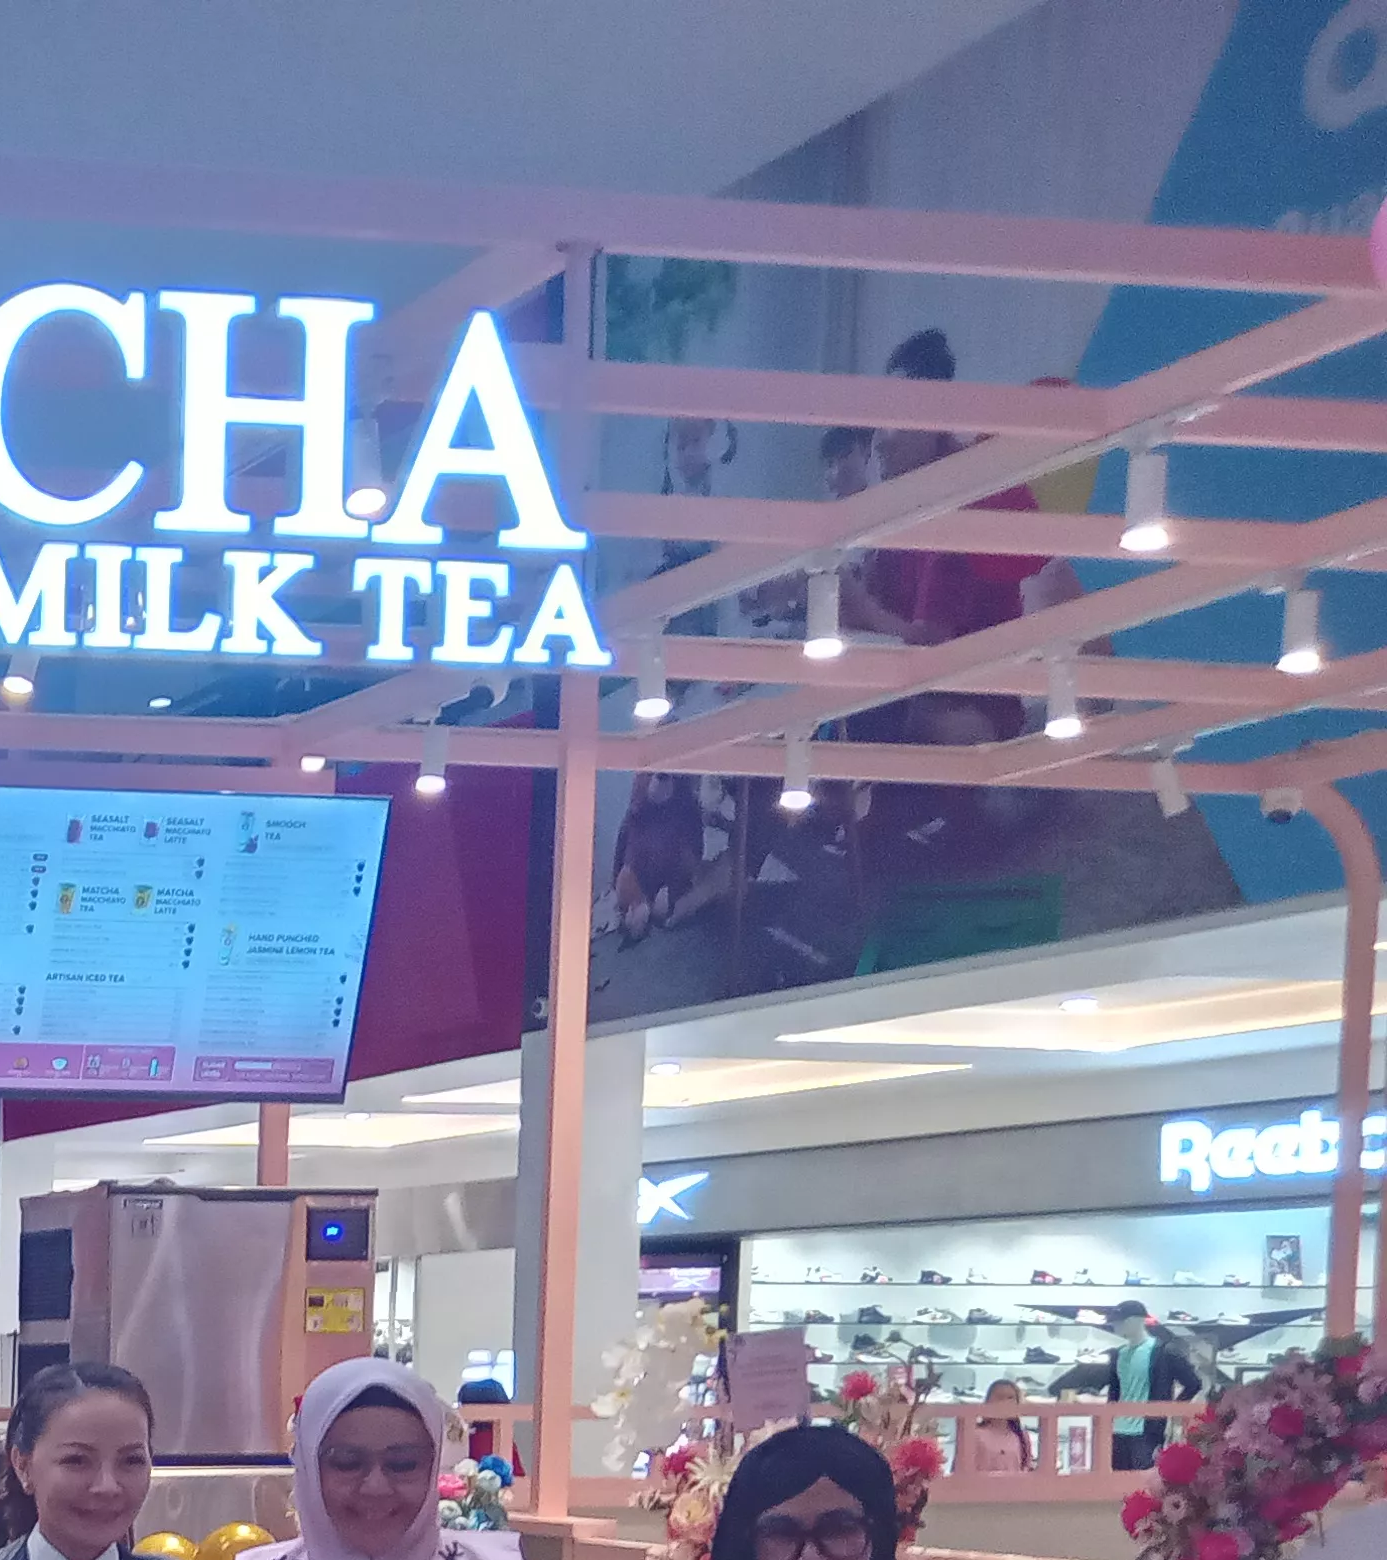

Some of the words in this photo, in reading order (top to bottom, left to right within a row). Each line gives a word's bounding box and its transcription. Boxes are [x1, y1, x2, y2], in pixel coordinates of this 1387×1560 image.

[354, 556, 615, 670] TEA
[89, 833, 105, 842] TEA
[264, 832, 282, 841] TEA
[81, 886, 121, 895] MATCHA
[156, 888, 195, 898] MATCHA
[79, 904, 95, 913] TEA
[318, 948, 336, 956] TEA
[45, 972, 84, 983] ARTISAN
[85, 974, 107, 982] ICED
[108, 974, 126, 983] TEA
